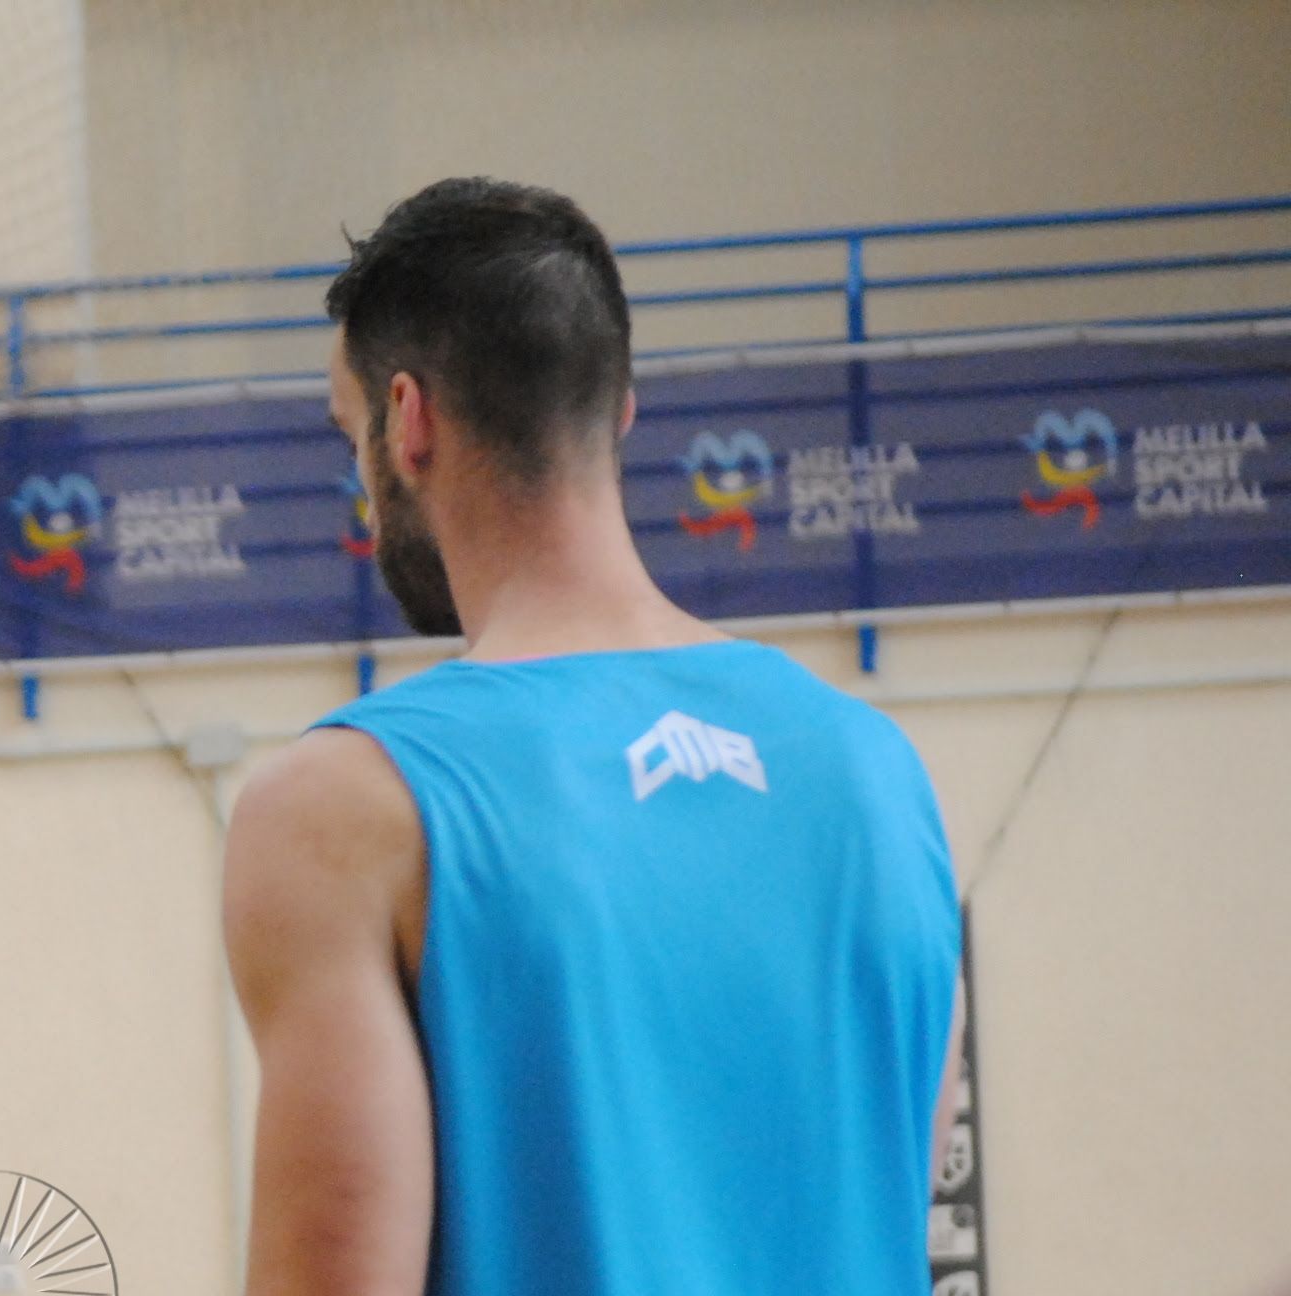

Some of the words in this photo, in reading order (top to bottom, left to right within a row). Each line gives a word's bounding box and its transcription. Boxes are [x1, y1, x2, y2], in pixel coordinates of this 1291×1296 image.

[1134, 421, 1267, 453] MELILLA
[787, 442, 919, 474] MELILLA
[1135, 449, 1241, 483] SPORT
[789, 472, 894, 506] SPORT
[1135, 478, 1267, 518] CAPITAL
[788, 501, 920, 538] CAPITAL
